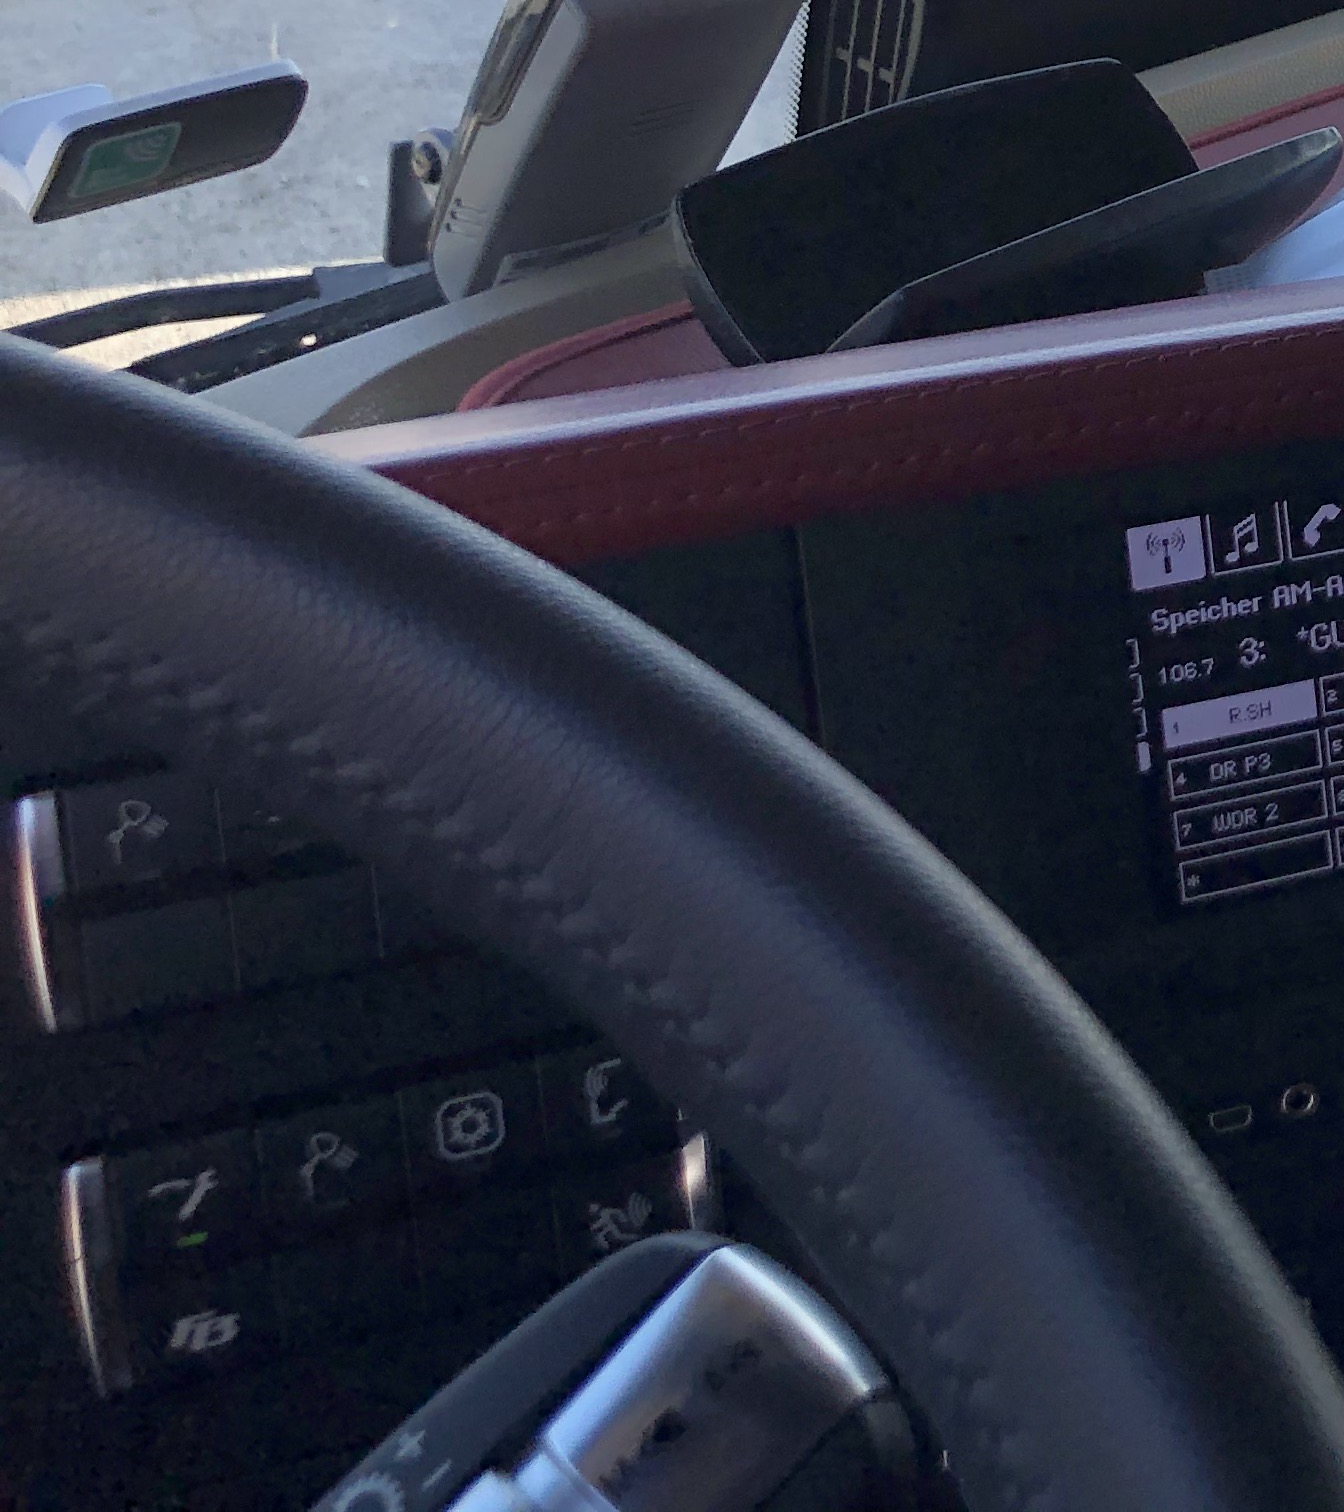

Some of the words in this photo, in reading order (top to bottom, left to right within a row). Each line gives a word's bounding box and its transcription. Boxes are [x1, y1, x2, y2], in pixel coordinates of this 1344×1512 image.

[1151, 595, 1262, 634] Speicher
[1158, 658, 1216, 685] 106.7
[1244, 752, 1271, 773] P3
[1264, 801, 1279, 822] 2
